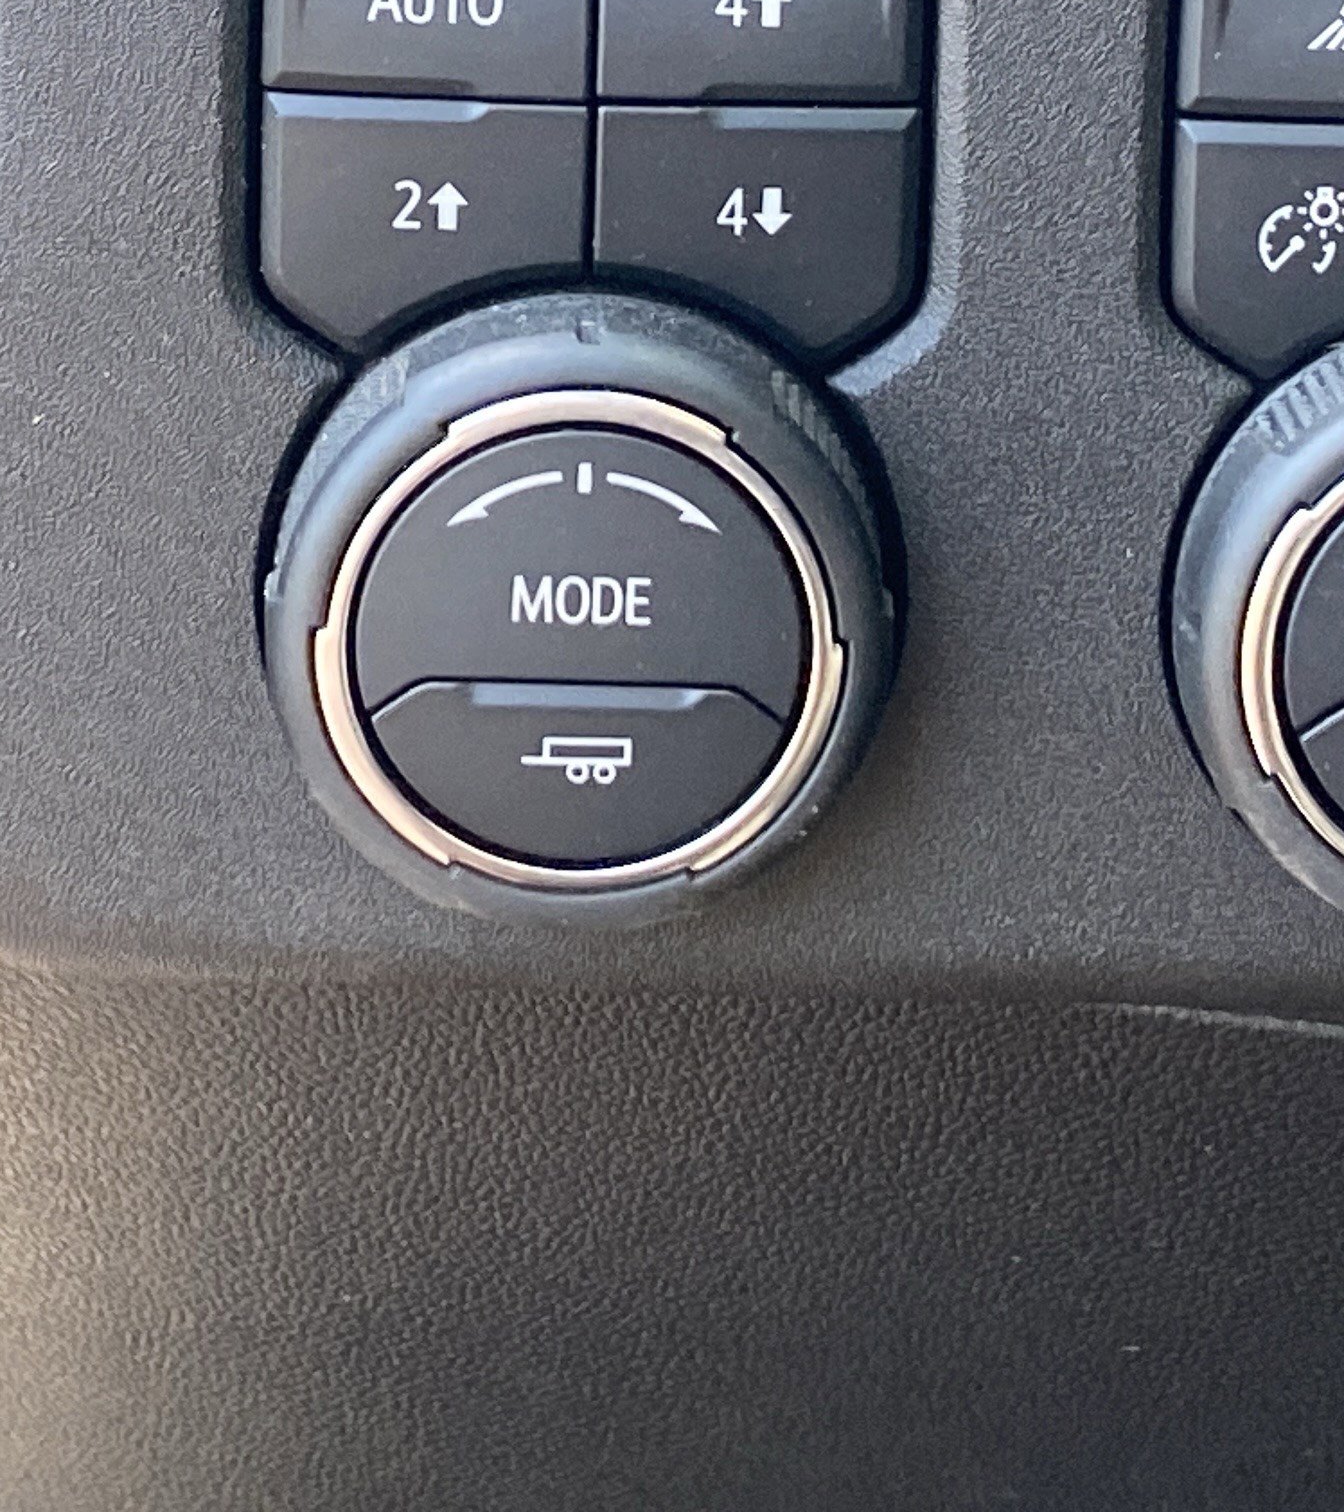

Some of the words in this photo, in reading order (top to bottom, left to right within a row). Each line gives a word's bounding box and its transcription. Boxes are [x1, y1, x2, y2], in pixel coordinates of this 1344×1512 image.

[390, 179, 422, 231] 2
[715, 187, 748, 237] 4
[511, 574, 652, 626] MODE
